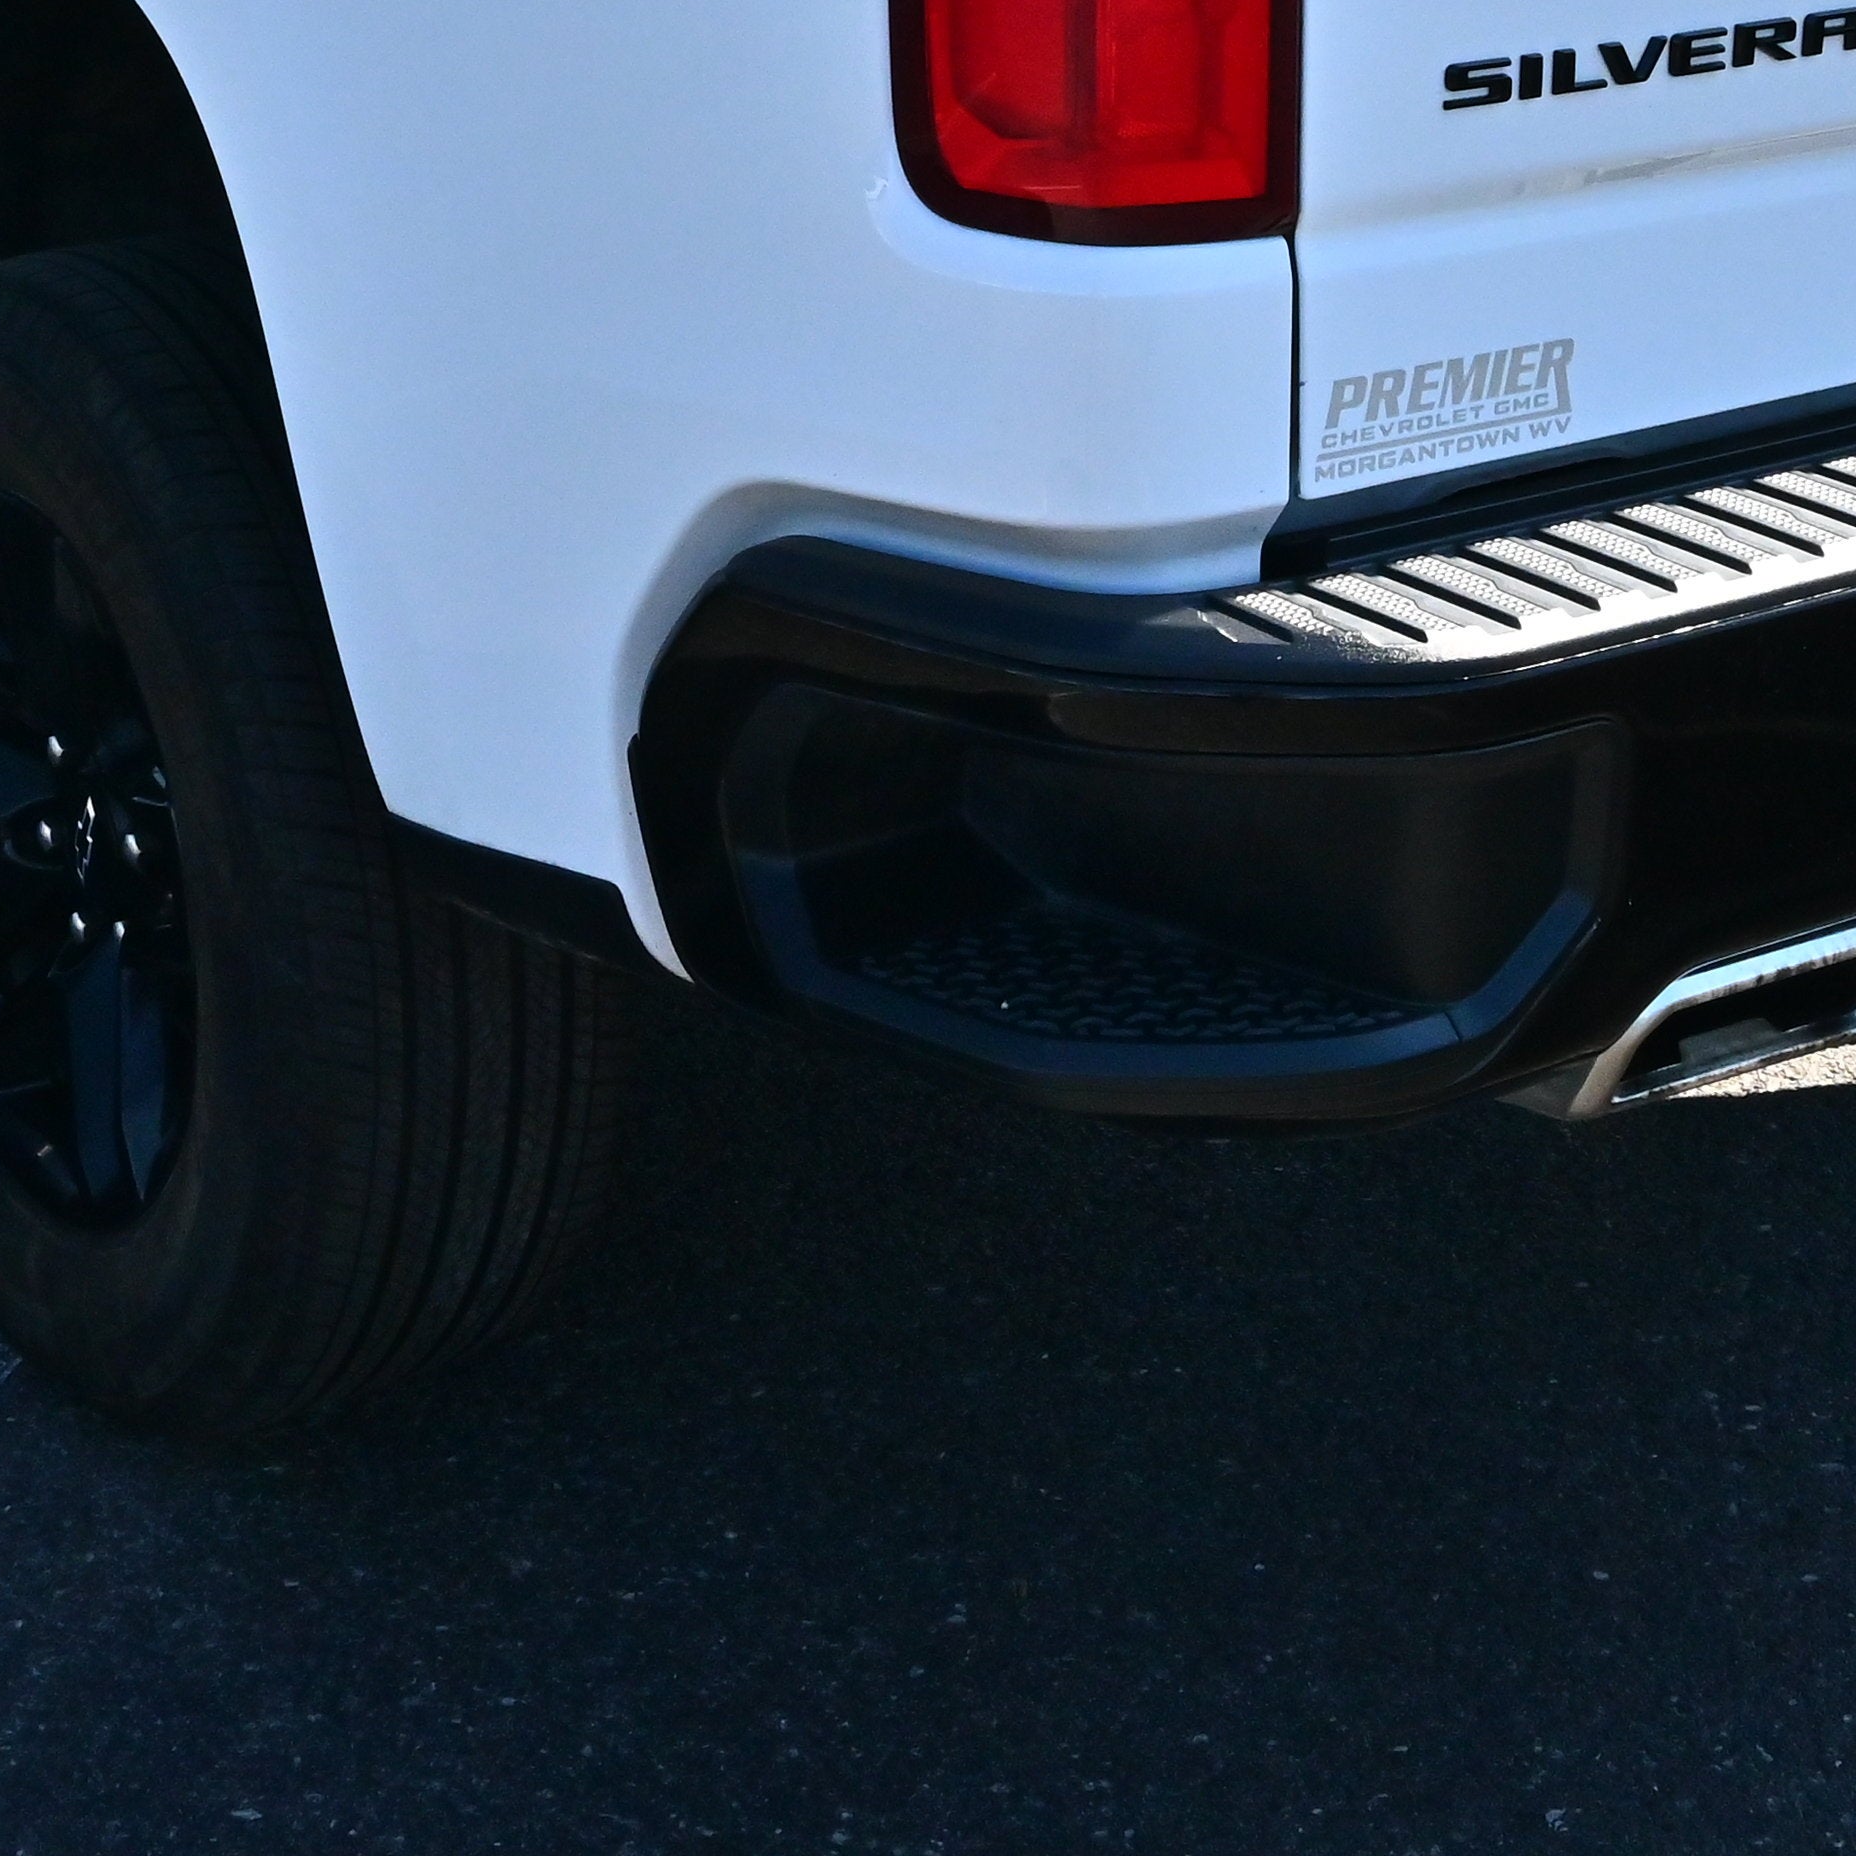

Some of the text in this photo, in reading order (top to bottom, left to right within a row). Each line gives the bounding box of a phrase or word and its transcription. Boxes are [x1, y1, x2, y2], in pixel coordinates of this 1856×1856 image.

[1324, 337, 1575, 430] PREMIER
[1314, 415, 1572, 483] MORGANTOWN WV
[1320, 392, 1550, 450] CHEVROLET GMC
